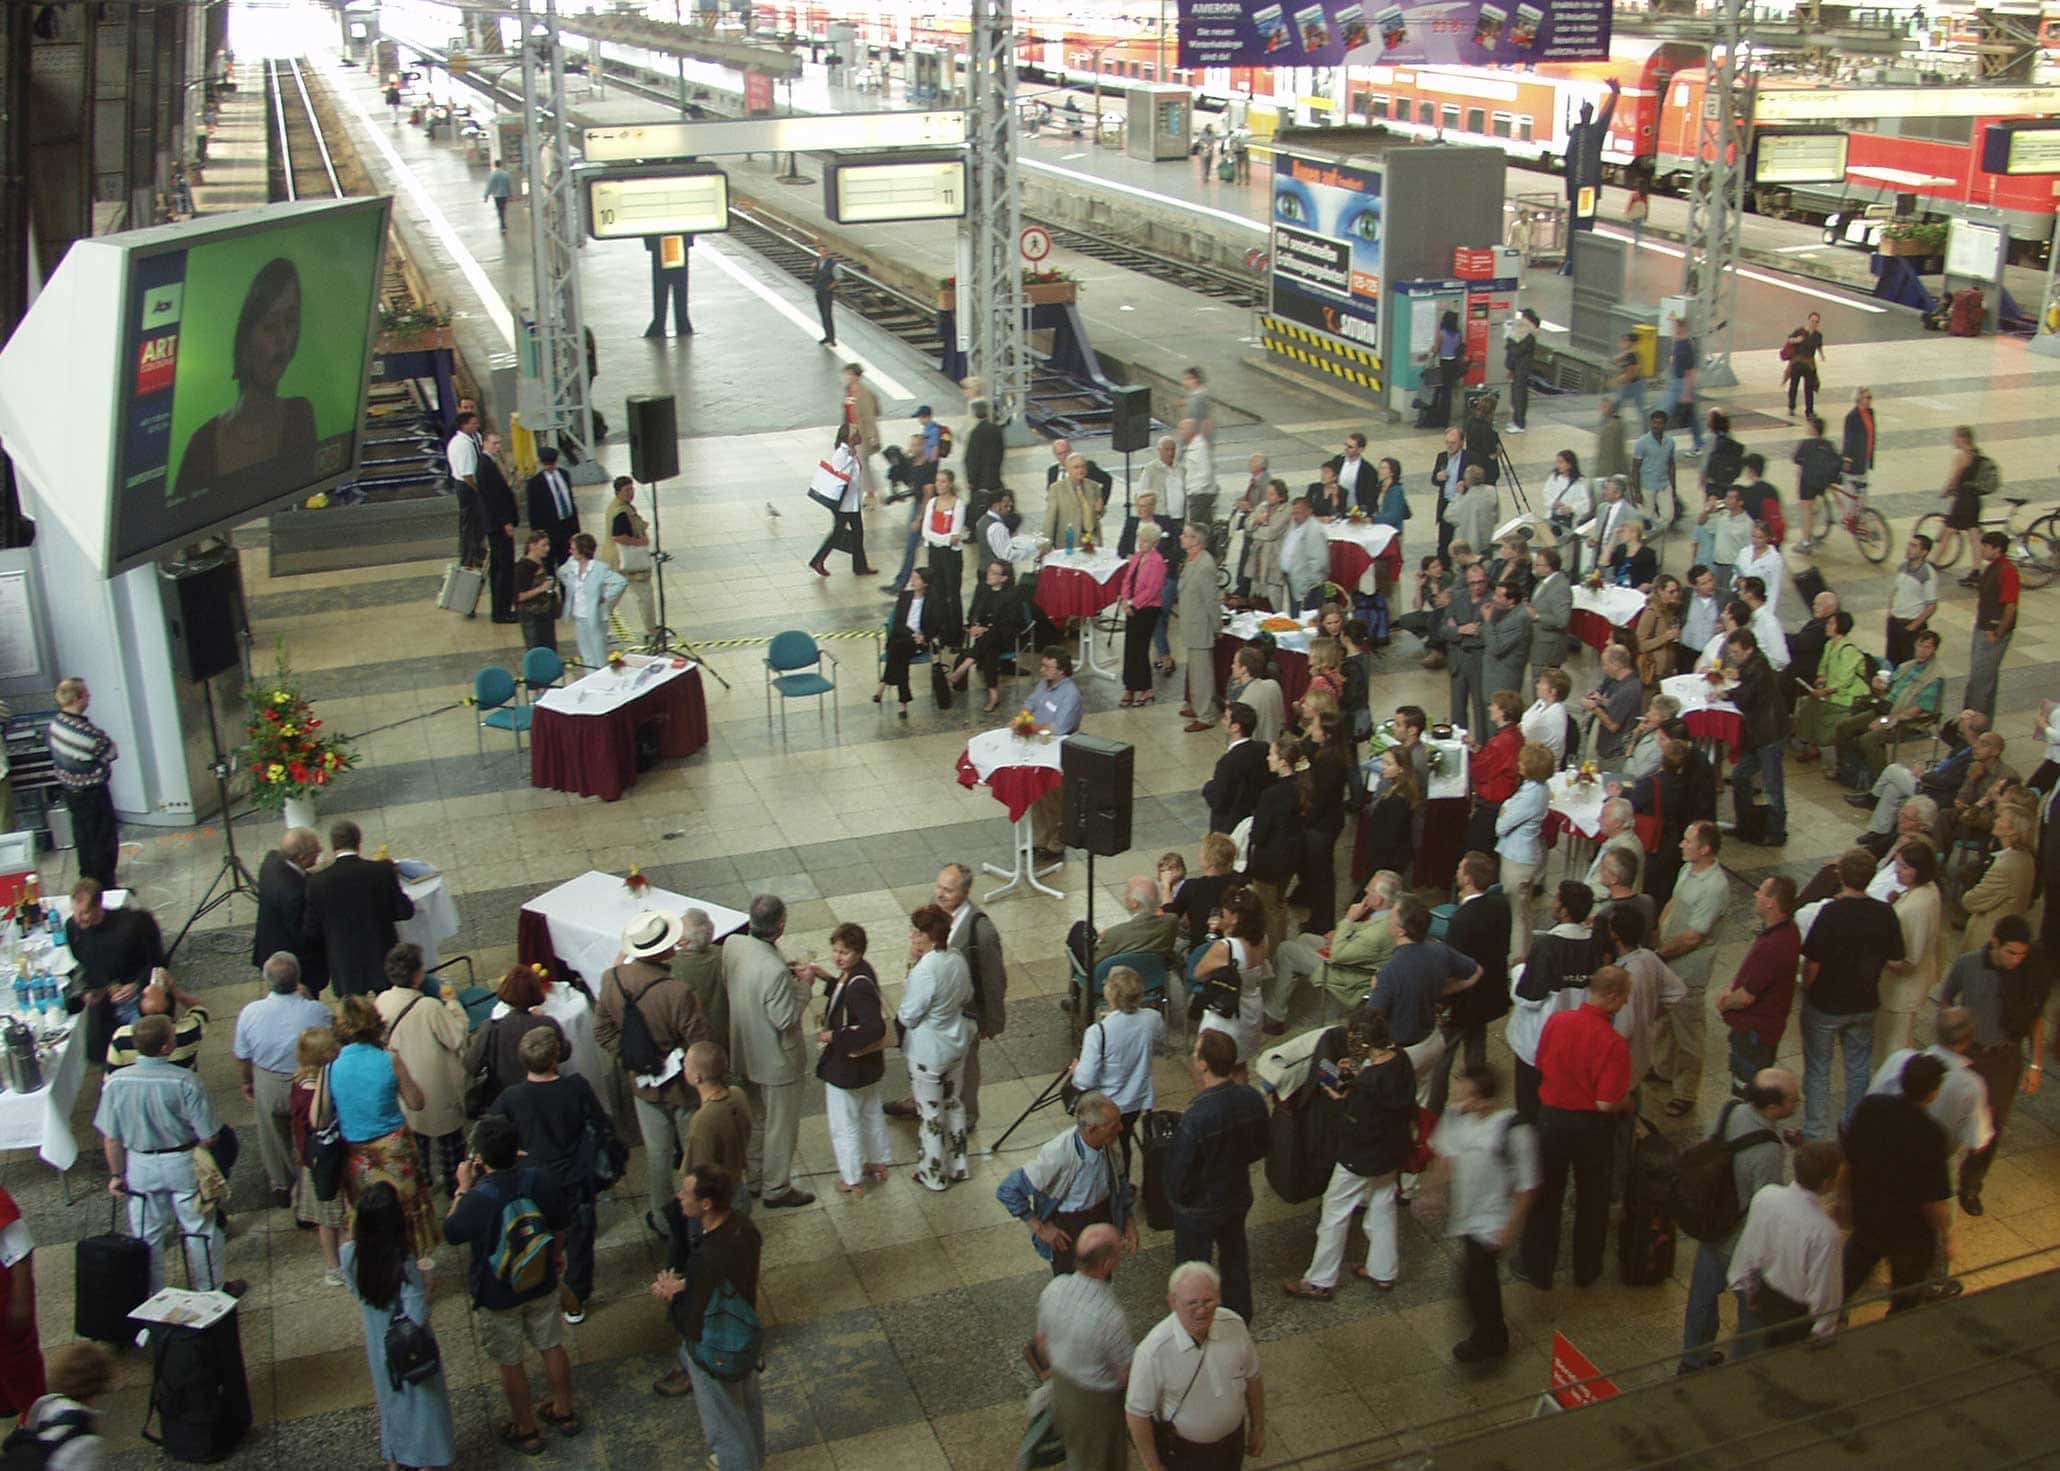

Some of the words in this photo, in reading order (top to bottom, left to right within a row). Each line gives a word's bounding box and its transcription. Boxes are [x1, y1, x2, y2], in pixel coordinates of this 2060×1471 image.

[1191, 3, 1242, 14] AMEROPA
[942, 189, 954, 205] 11
[599, 208, 615, 225] 10
[141, 334, 177, 364] ART
